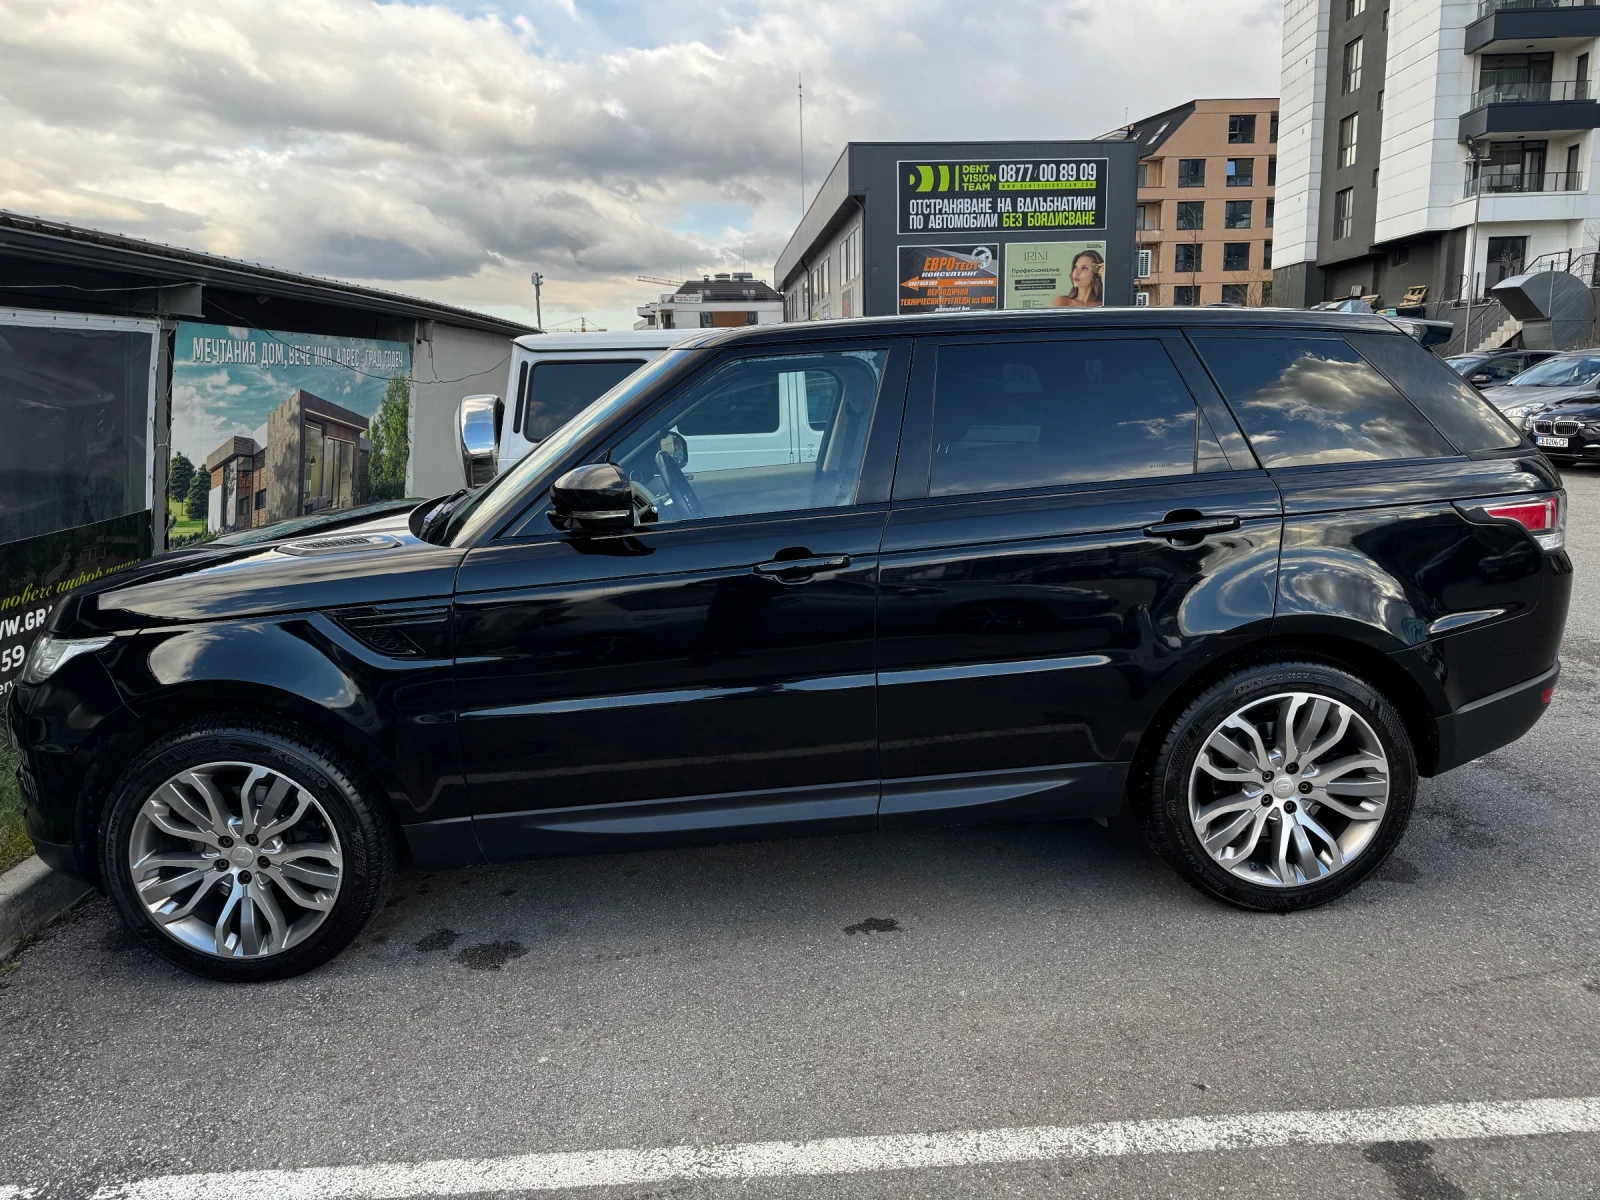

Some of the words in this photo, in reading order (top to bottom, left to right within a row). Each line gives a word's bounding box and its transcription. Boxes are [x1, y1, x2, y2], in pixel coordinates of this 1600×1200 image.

[962, 165, 990, 173] DENT
[962, 174, 996, 182] VISION
[998, 164, 1033, 182] 0877
[1039, 163, 1057, 181] 00
[1059, 163, 1077, 181] 89
[1080, 162, 1097, 181] 09
[962, 183, 990, 191] TEAM
[909, 197, 993, 214] ОТСТРАНЯВАНЕ
[997, 197, 1012, 212] НА
[1016, 196, 1096, 212] ВДЛЪБНАТИНИ
[909, 214, 924, 229] ПО
[928, 213, 998, 229] АВТОМОБИЛИ
[1002, 213, 1023, 227] БЕЗ
[1027, 211, 1096, 226] БОЯДИСВАНЕ
[193, 337, 257, 364] МЕЧТАНИЯ
[260, 343, 288, 370] ДОМ,
[289, 344, 311, 366] ВЕЧЕ
[314, 346, 333, 367] ИМА
[336, 348, 360, 371] АДРЕС
[365, 349, 383, 371] ГРАД
